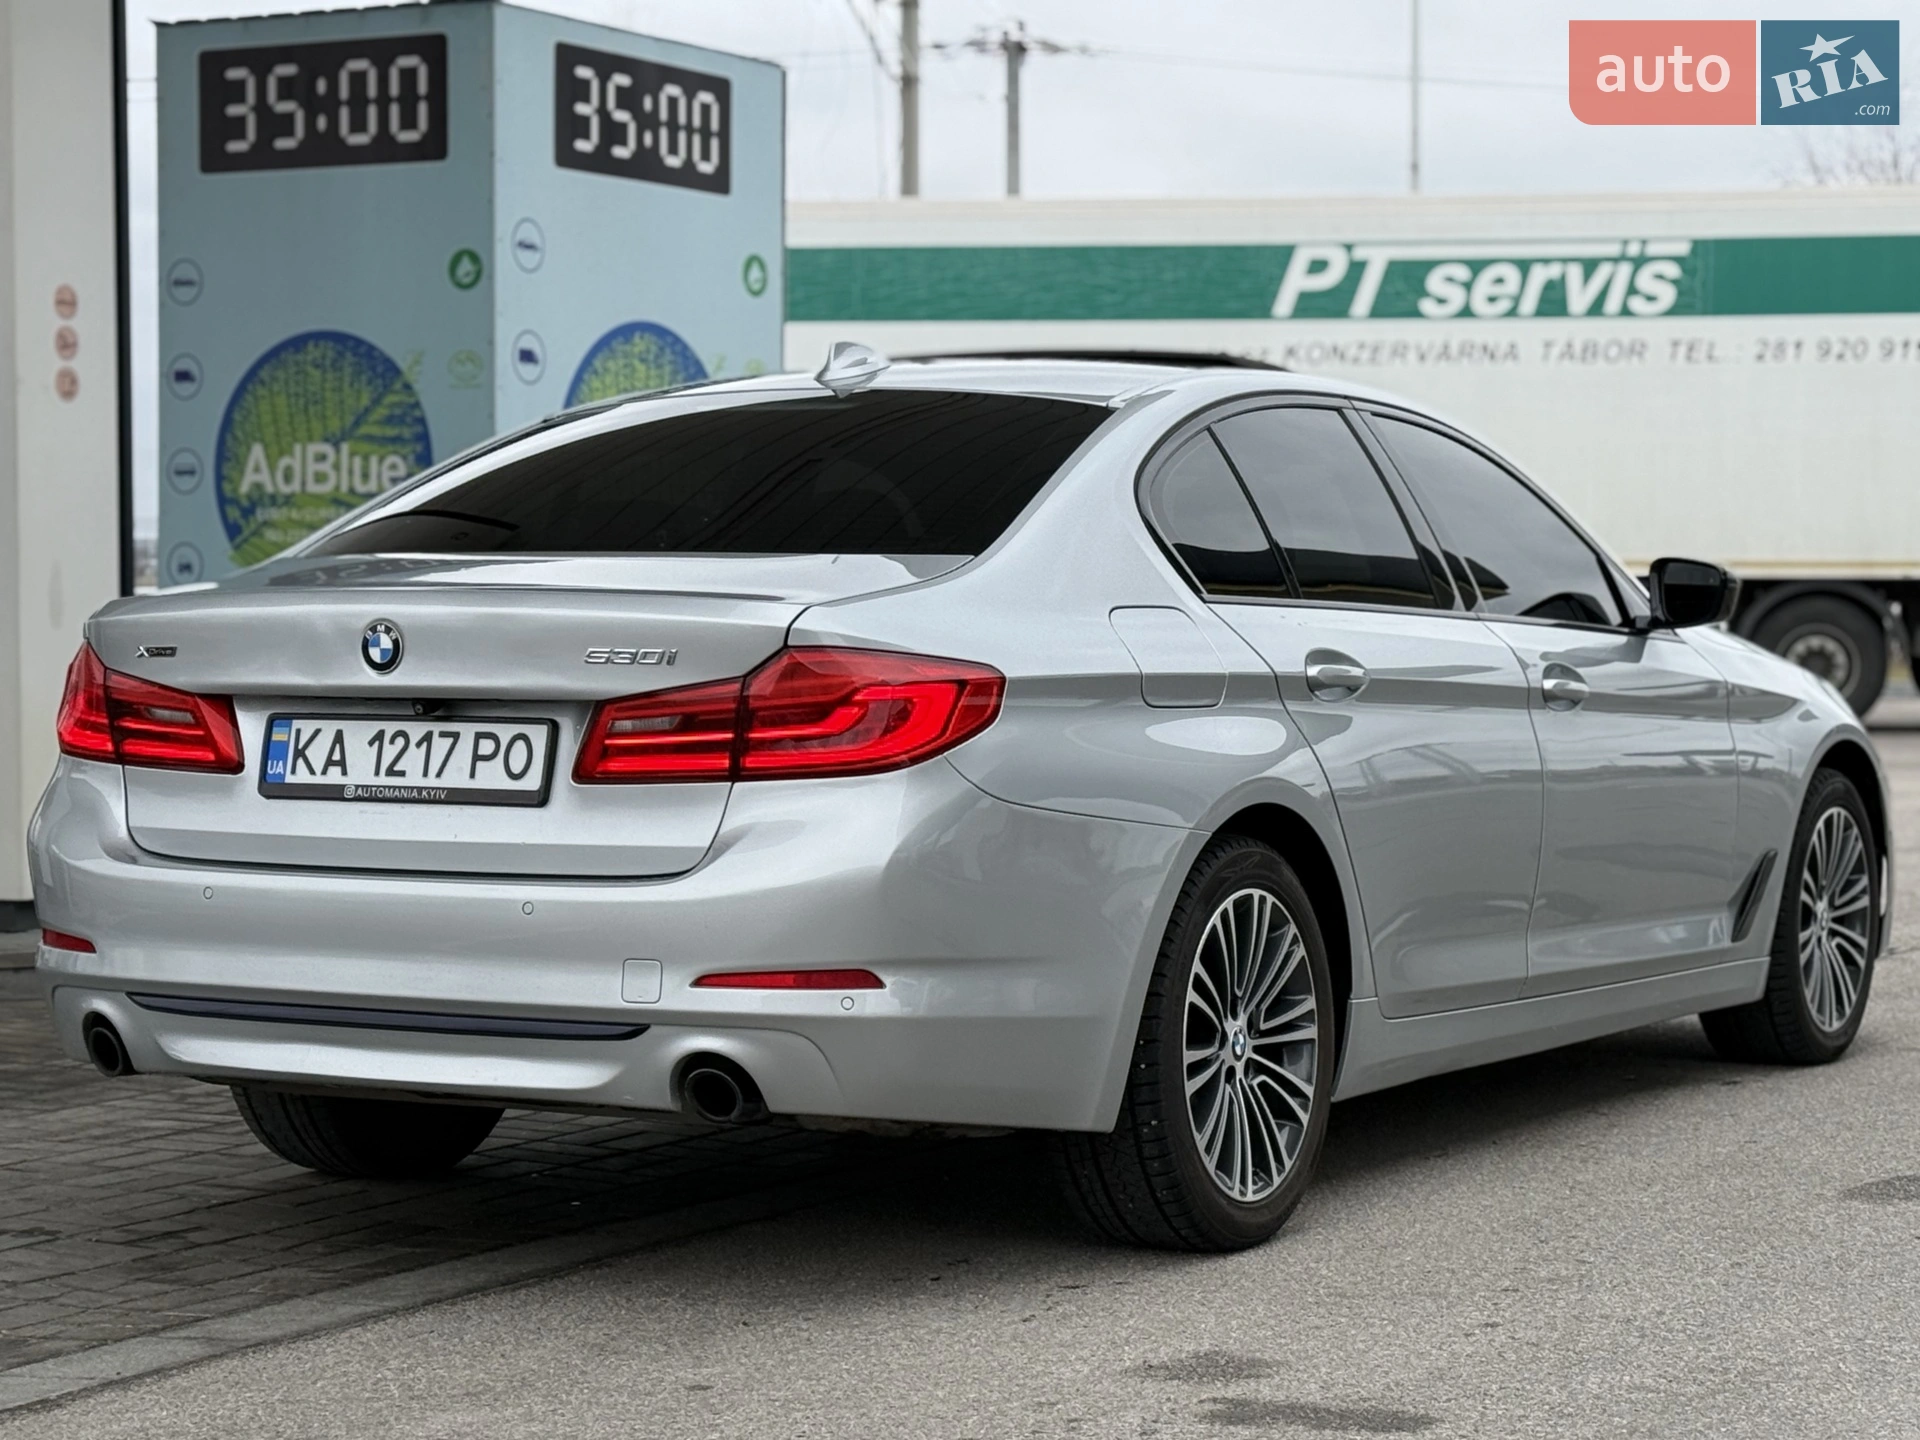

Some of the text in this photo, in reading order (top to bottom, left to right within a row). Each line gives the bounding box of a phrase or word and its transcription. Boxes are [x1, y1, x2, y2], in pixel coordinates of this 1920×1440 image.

[223, 54, 429, 153] 35:00
[573, 64, 720, 175] 35:00
[1270, 239, 1692, 319] PT servis
[1539, 335, 1647, 365] TÁBOR
[1753, 336, 1804, 363] 281
[1815, 336, 1870, 363] 920
[239, 443, 408, 494] AdBlue
[365, 624, 398, 641] BMW
[583, 647, 679, 666] 530i
[267, 760, 284, 774] UA
[290, 728, 533, 780] KA 1217 PO
[355, 787, 447, 799] AUTOMANIA.KYIV
